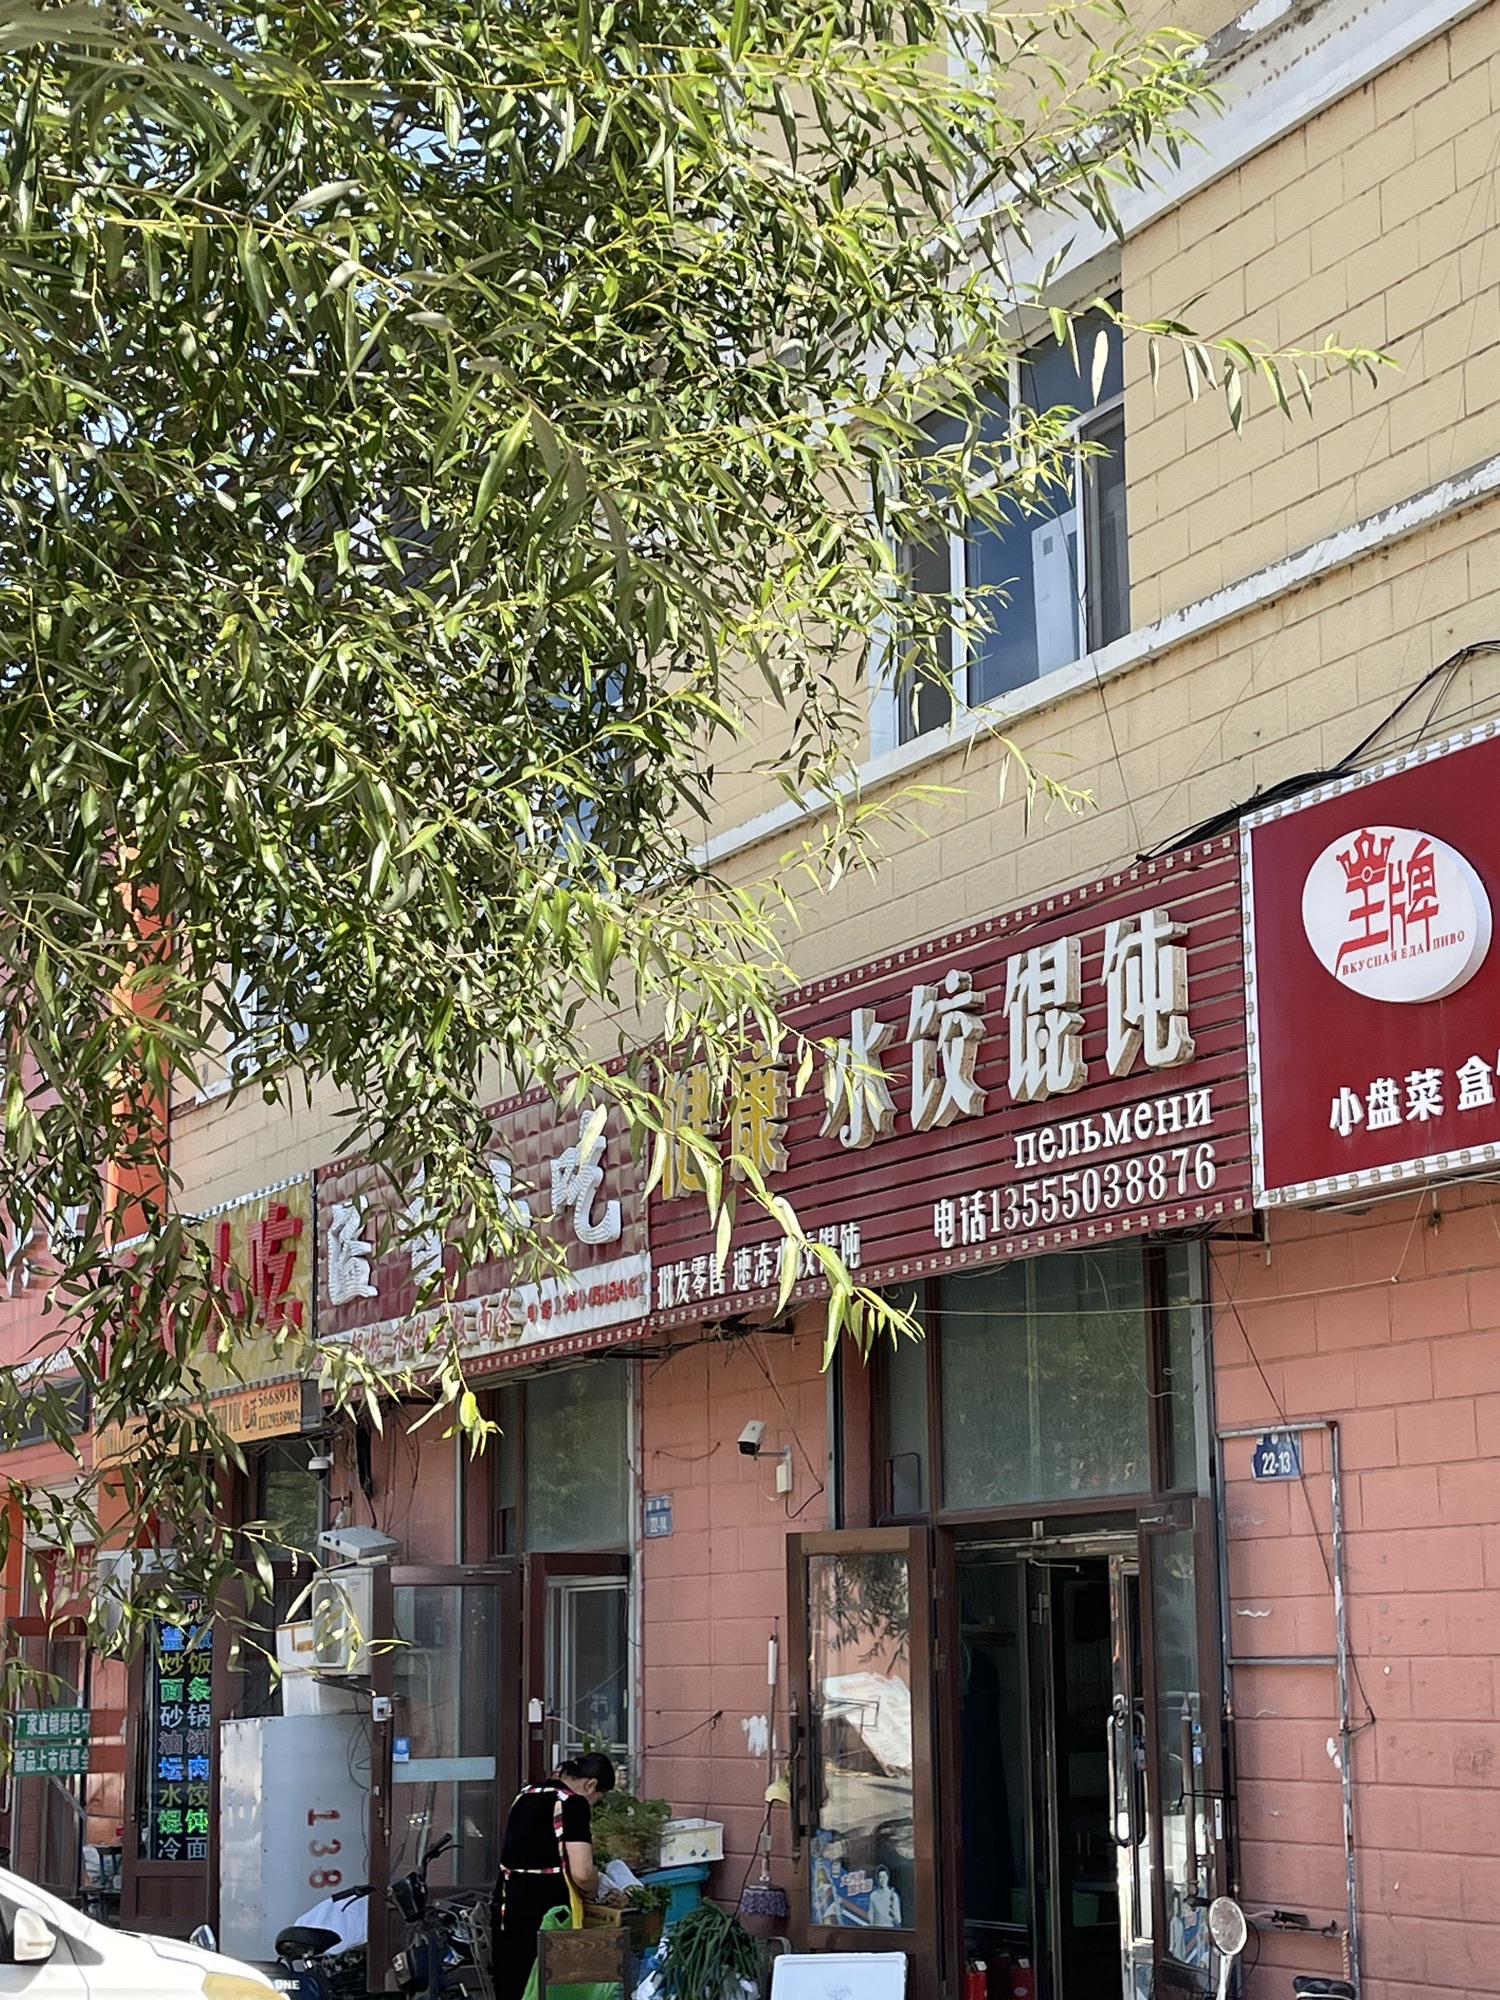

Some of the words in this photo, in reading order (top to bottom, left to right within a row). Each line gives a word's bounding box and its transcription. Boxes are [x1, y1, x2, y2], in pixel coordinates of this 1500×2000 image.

[1342, 951, 1397, 975] ВКУСНАЯ
[1401, 943, 1424, 960] ЕДА
[1433, 930, 1465, 950] ПИВО
[1330, 1068, 1444, 1137] 小盘菜
[1456, 1049, 1500, 1111] 盒
[1014, 1088, 1214, 1169] пельмени
[258, 1386, 299, 1408] 5668918
[1261, 1451, 1291, 1475] 22-13
[160, 1652, 213, 1677] 炒饭
[159, 1677, 211, 1703] 面条
[159, 1704, 211, 1729] 砂锅
[159, 1729, 211, 1756] 油饼
[158, 1756, 210, 1781] 坛肉
[158, 1783, 209, 1808] 水饺
[157, 1808, 210, 1835] 馄饨
[157, 1836, 208, 1861] 冷面
[308, 1808, 342, 1889] 138
